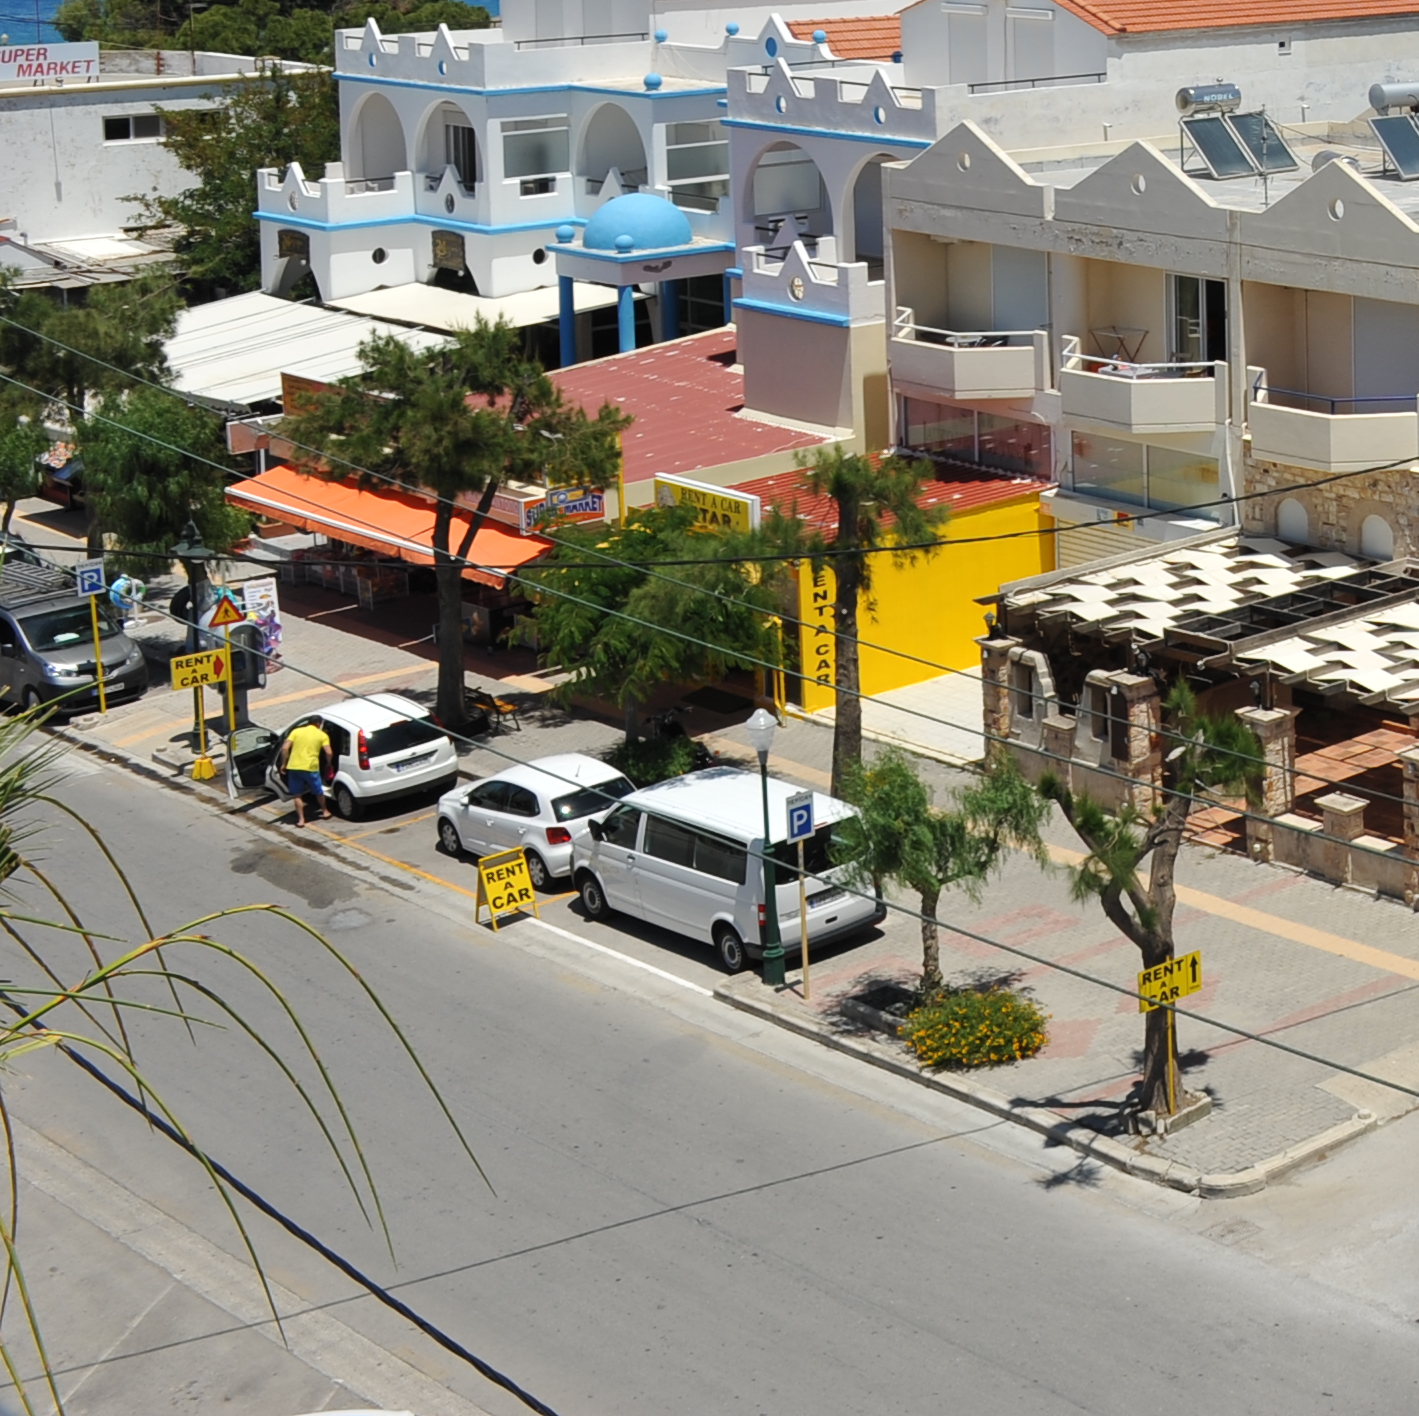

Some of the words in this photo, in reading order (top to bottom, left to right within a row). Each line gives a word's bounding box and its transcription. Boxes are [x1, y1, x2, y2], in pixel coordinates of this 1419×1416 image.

[0, 47, 48, 64] UPER
[16, 59, 96, 78] MARKET
[1203, 93, 1235, 103] NOBEL
[681, 487, 708, 506] RENT
[711, 496, 718, 510] A
[721, 498, 742, 515] CAR
[83, 571, 98, 591] P
[812, 574, 829, 617] ENT
[175, 654, 213, 670] RENT
[815, 644, 831, 687] CAR
[180, 673, 209, 687] CAR
[792, 809, 808, 835] P
[485, 862, 524, 884] RENT
[503, 881, 515, 891] A
[492, 887, 532, 910] CAR
[1142, 959, 1185, 985] RENT
[1160, 980, 1168, 990] A
[1147, 986, 1180, 1008] CAR
